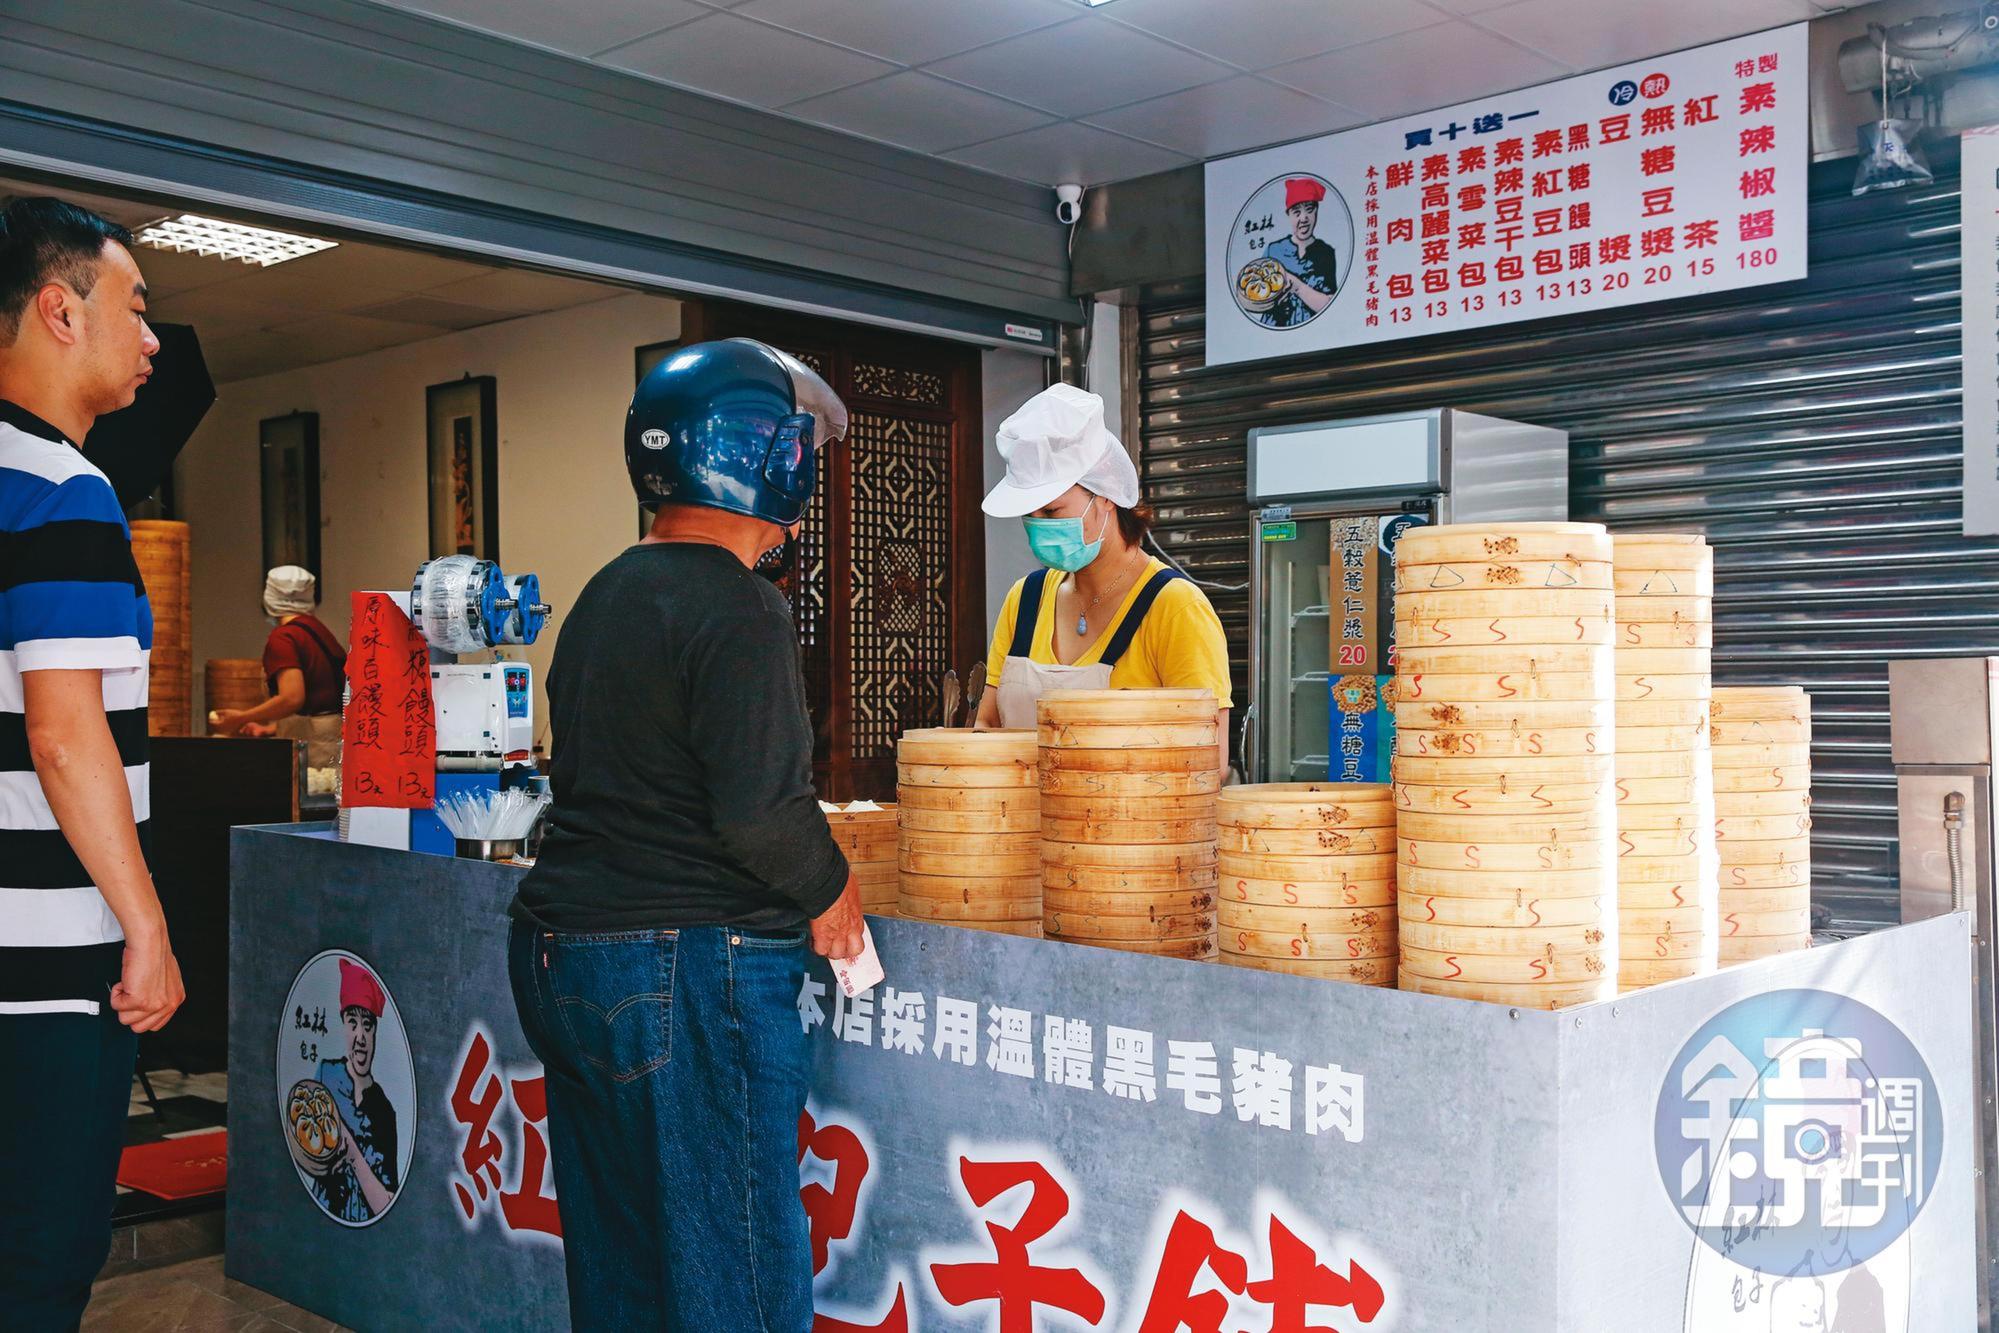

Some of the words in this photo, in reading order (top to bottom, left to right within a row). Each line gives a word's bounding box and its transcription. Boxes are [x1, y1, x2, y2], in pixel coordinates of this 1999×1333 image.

[1735, 53, 1777, 78] 特製
[1405, 110, 1539, 150] 買十送一
[1739, 82, 1776, 241] 素辣椒醬
[1532, 129, 1563, 276] 素紅豆包
[1568, 122, 1591, 270] 黑糖饅頭
[1457, 146, 1486, 288] 素雪菜包
[1494, 138, 1524, 282] 素辣豆干包
[1386, 160, 1414, 299] 鮮肉包
[1421, 153, 1449, 294] 素高麗菜包
[1687, 258, 1715, 277] 15
[1736, 248, 1777, 269] 180
[1602, 272, 1629, 291] 20
[1644, 265, 1671, 284] 20
[1498, 289, 1522, 307] 13
[1536, 283, 1560, 300] 13
[1567, 278, 1592, 296] 13
[1390, 306, 1412, 323] 13
[1424, 301, 1447, 318] 13
[1461, 295, 1484, 312] 13
[643, 435, 667, 445] YMT
[1339, 644, 1366, 666] 20
[1341, 711, 1364, 782] 無糖豆
[797, 972, 1365, 1143] 本店採用溫體黑毛豬肉
